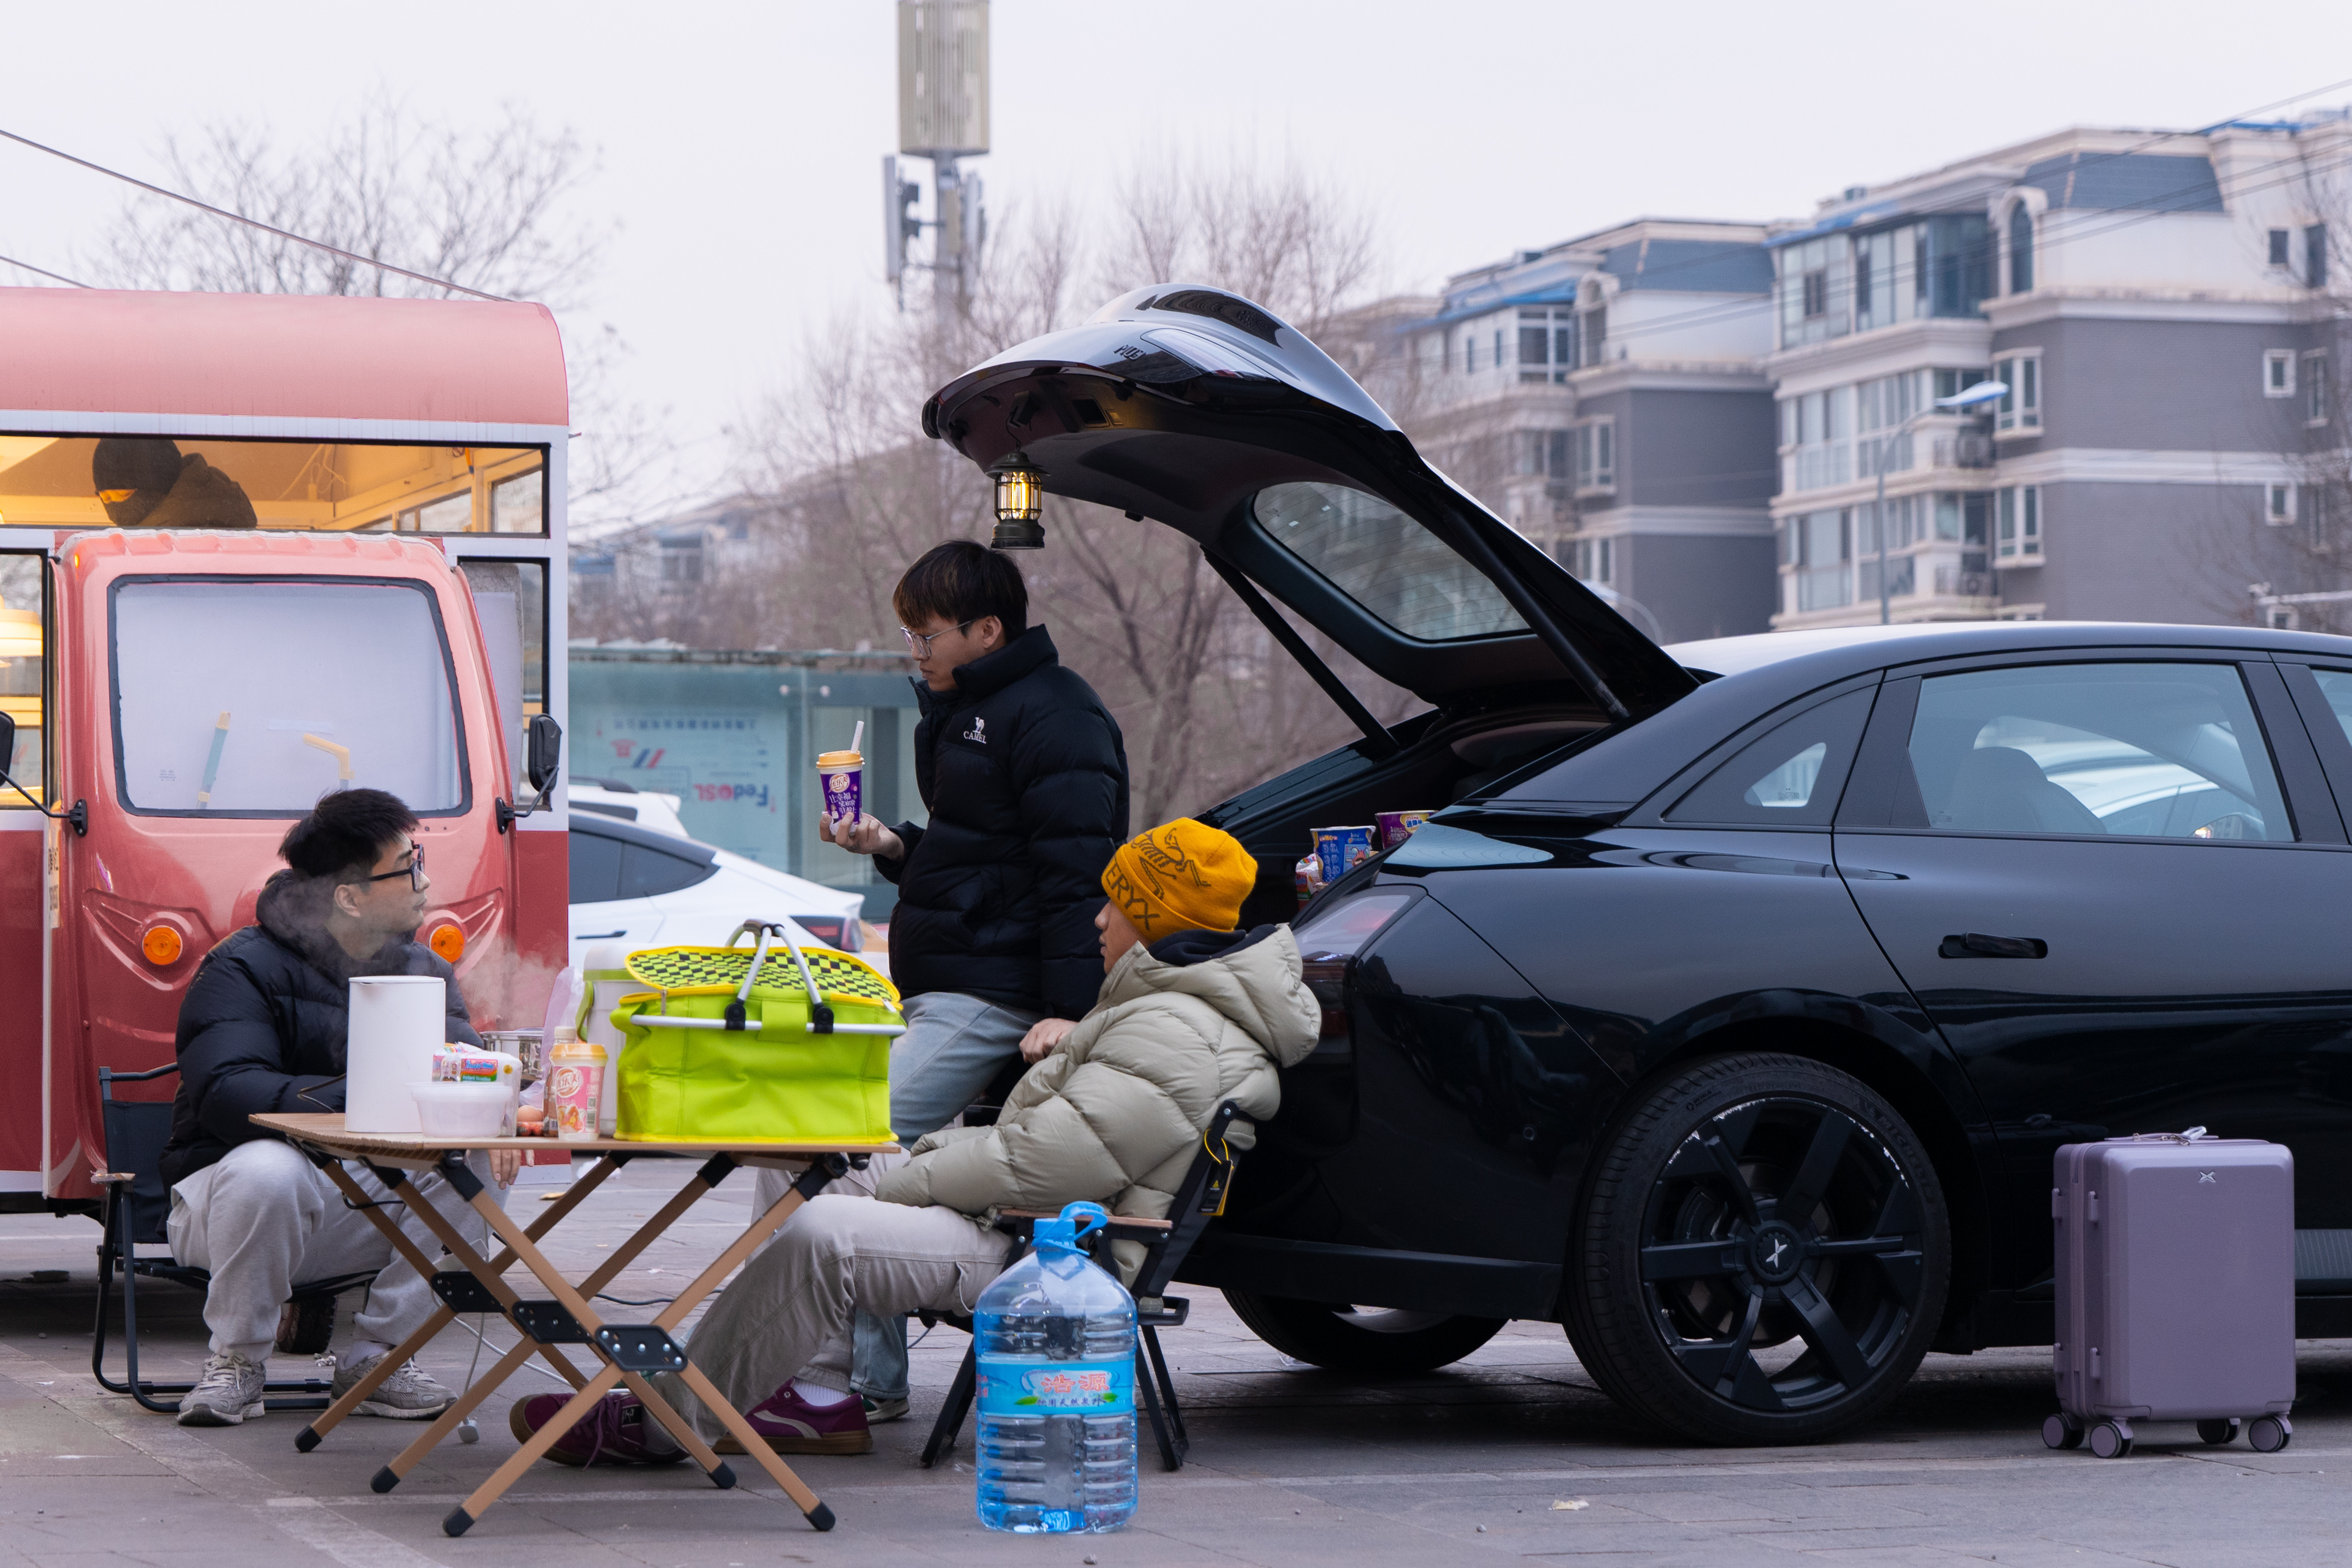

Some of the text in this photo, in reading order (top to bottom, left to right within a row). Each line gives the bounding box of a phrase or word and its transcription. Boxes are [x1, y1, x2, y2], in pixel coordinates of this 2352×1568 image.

[964, 731, 987, 744] CAMEL
[1878, 1114, 1933, 1199] MICHELIN
[1040, 1374, 1109, 1393] 浩源
